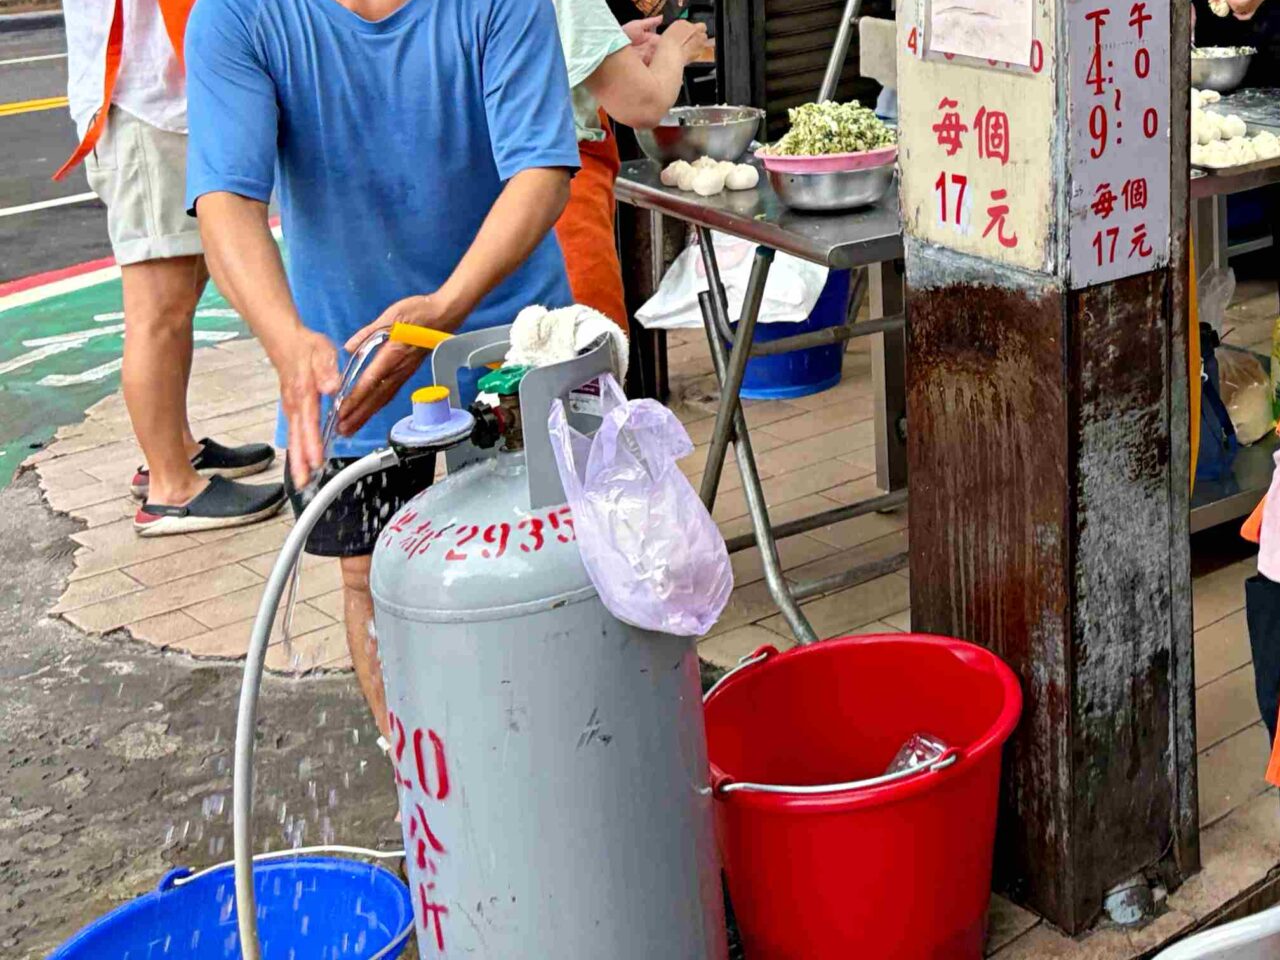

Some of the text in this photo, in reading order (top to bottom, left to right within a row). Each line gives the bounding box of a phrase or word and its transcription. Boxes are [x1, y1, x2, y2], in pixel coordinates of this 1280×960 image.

[1085, 2, 1152, 44] 下午
[932, 96, 1010, 166] 每個
[1091, 178, 1148, 220] 每個
